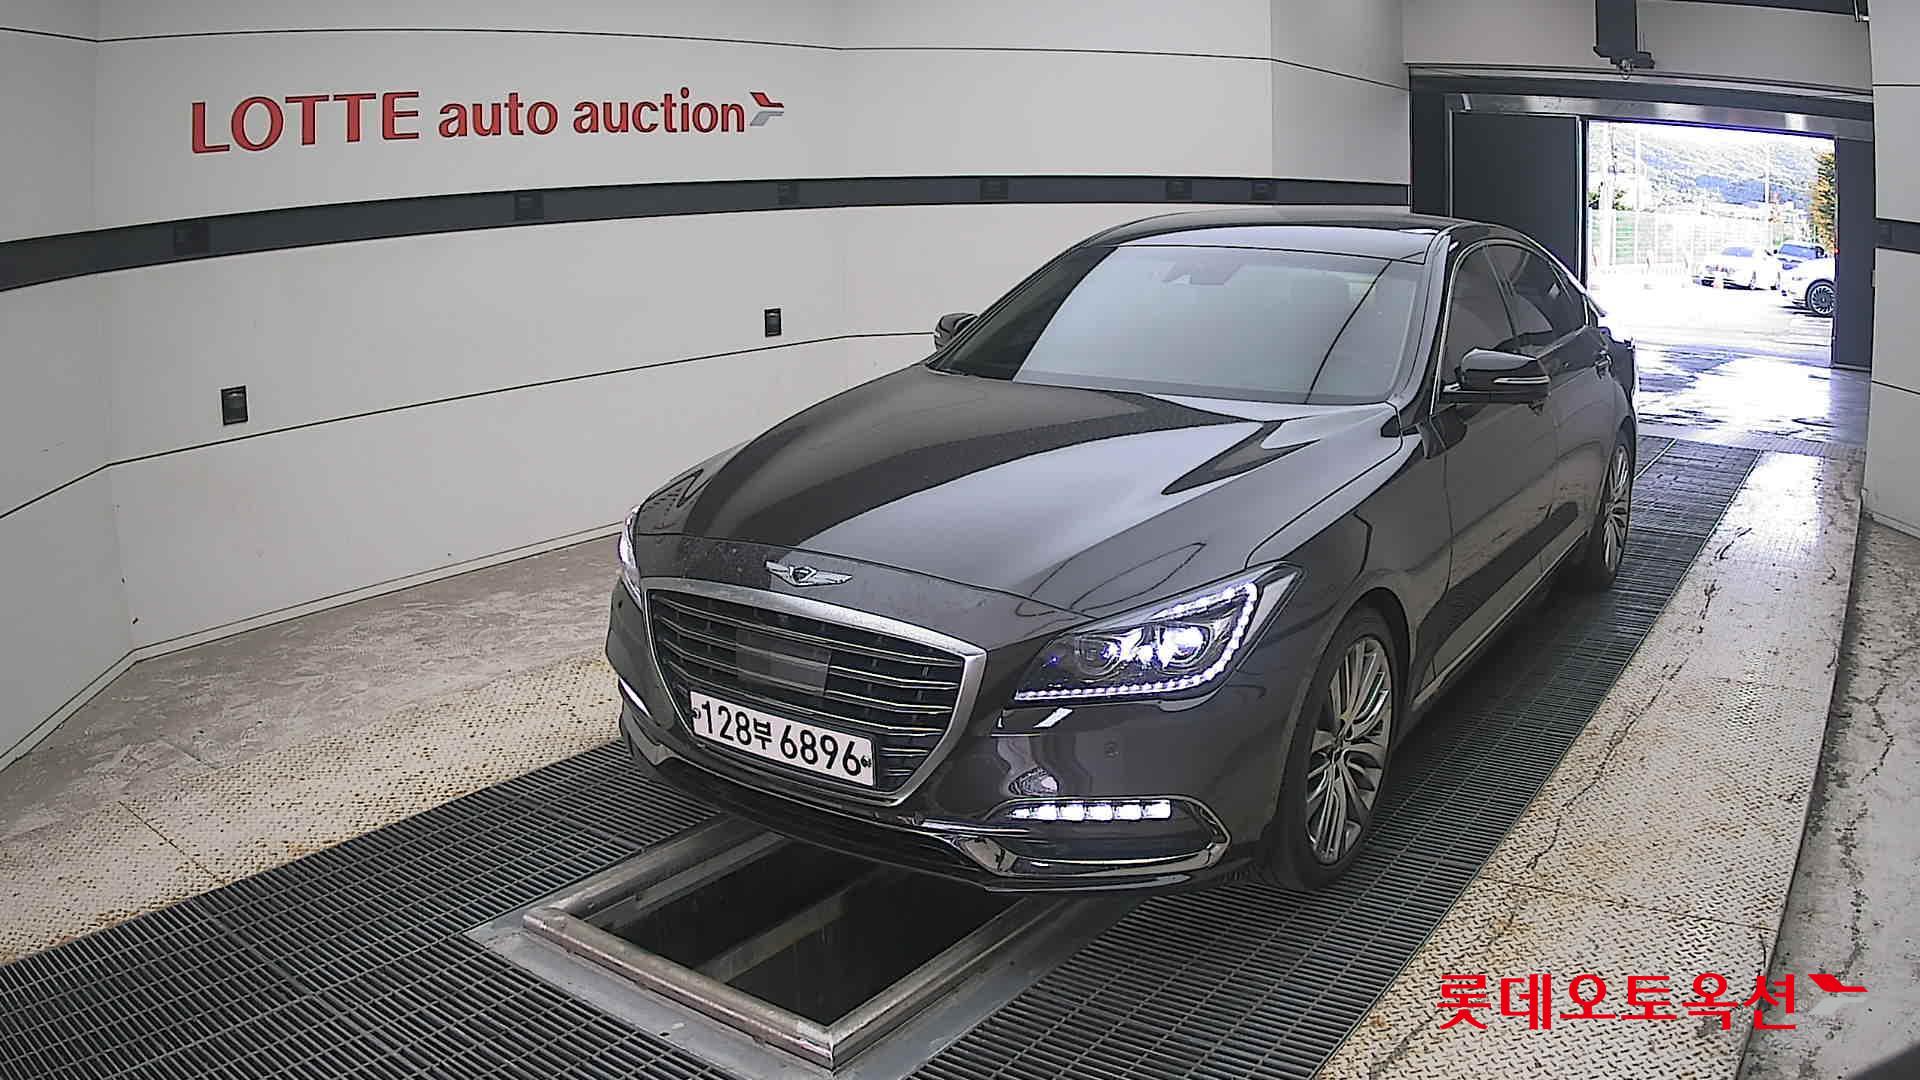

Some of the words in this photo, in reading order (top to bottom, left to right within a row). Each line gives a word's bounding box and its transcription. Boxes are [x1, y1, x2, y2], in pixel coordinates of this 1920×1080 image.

[191, 91, 420, 154] LOTTE
[438, 92, 558, 137] auto
[573, 87, 745, 134] auction
[701, 701, 773, 750] 128부
[780, 725, 862, 776] 6896
